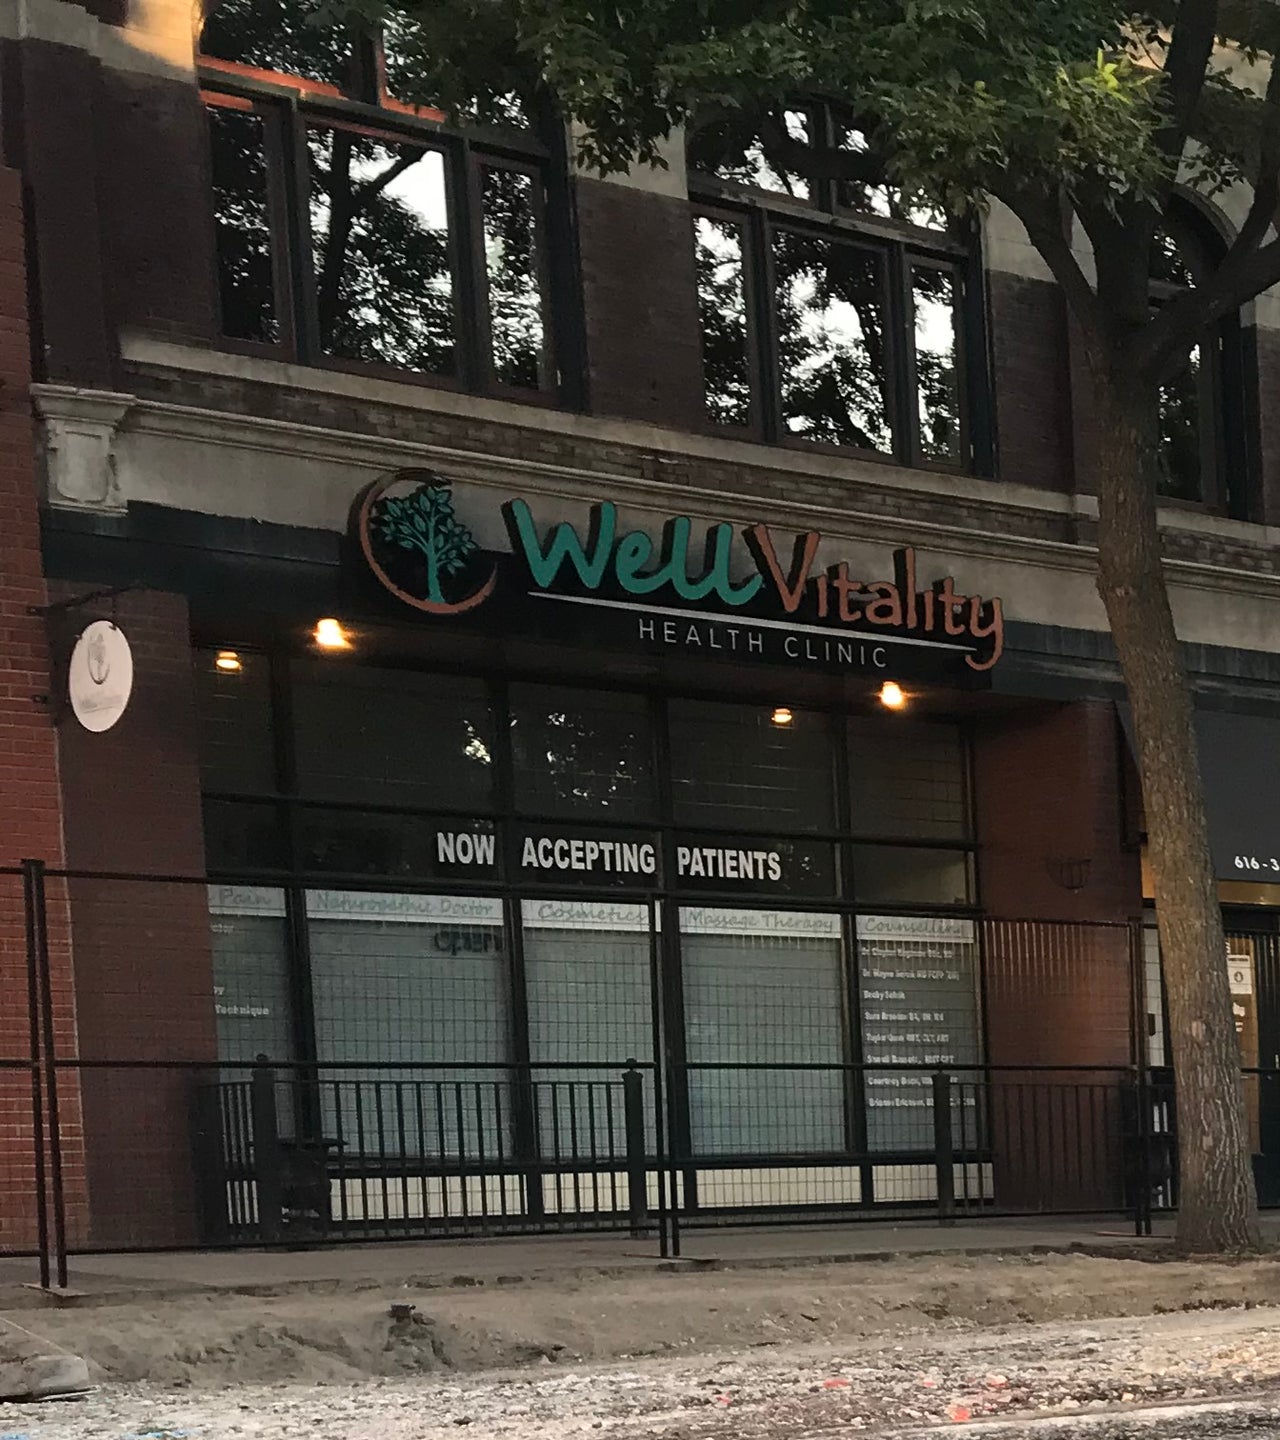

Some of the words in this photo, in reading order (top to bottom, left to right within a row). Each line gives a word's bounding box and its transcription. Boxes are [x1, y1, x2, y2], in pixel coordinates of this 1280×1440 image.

[638, 617, 765, 655] HEALTH
[784, 636, 888, 668] CLINIC
[437, 832, 495, 865] NOW
[521, 837, 656, 874] ACCEPTING
[677, 846, 782, 881] PATIENTS
[1234, 855, 1260, 870] 616
[1270, 858, 1280, 871] 3
[761, 912, 833, 933] Therapy
[215, 1004, 270, 1018] Technique
